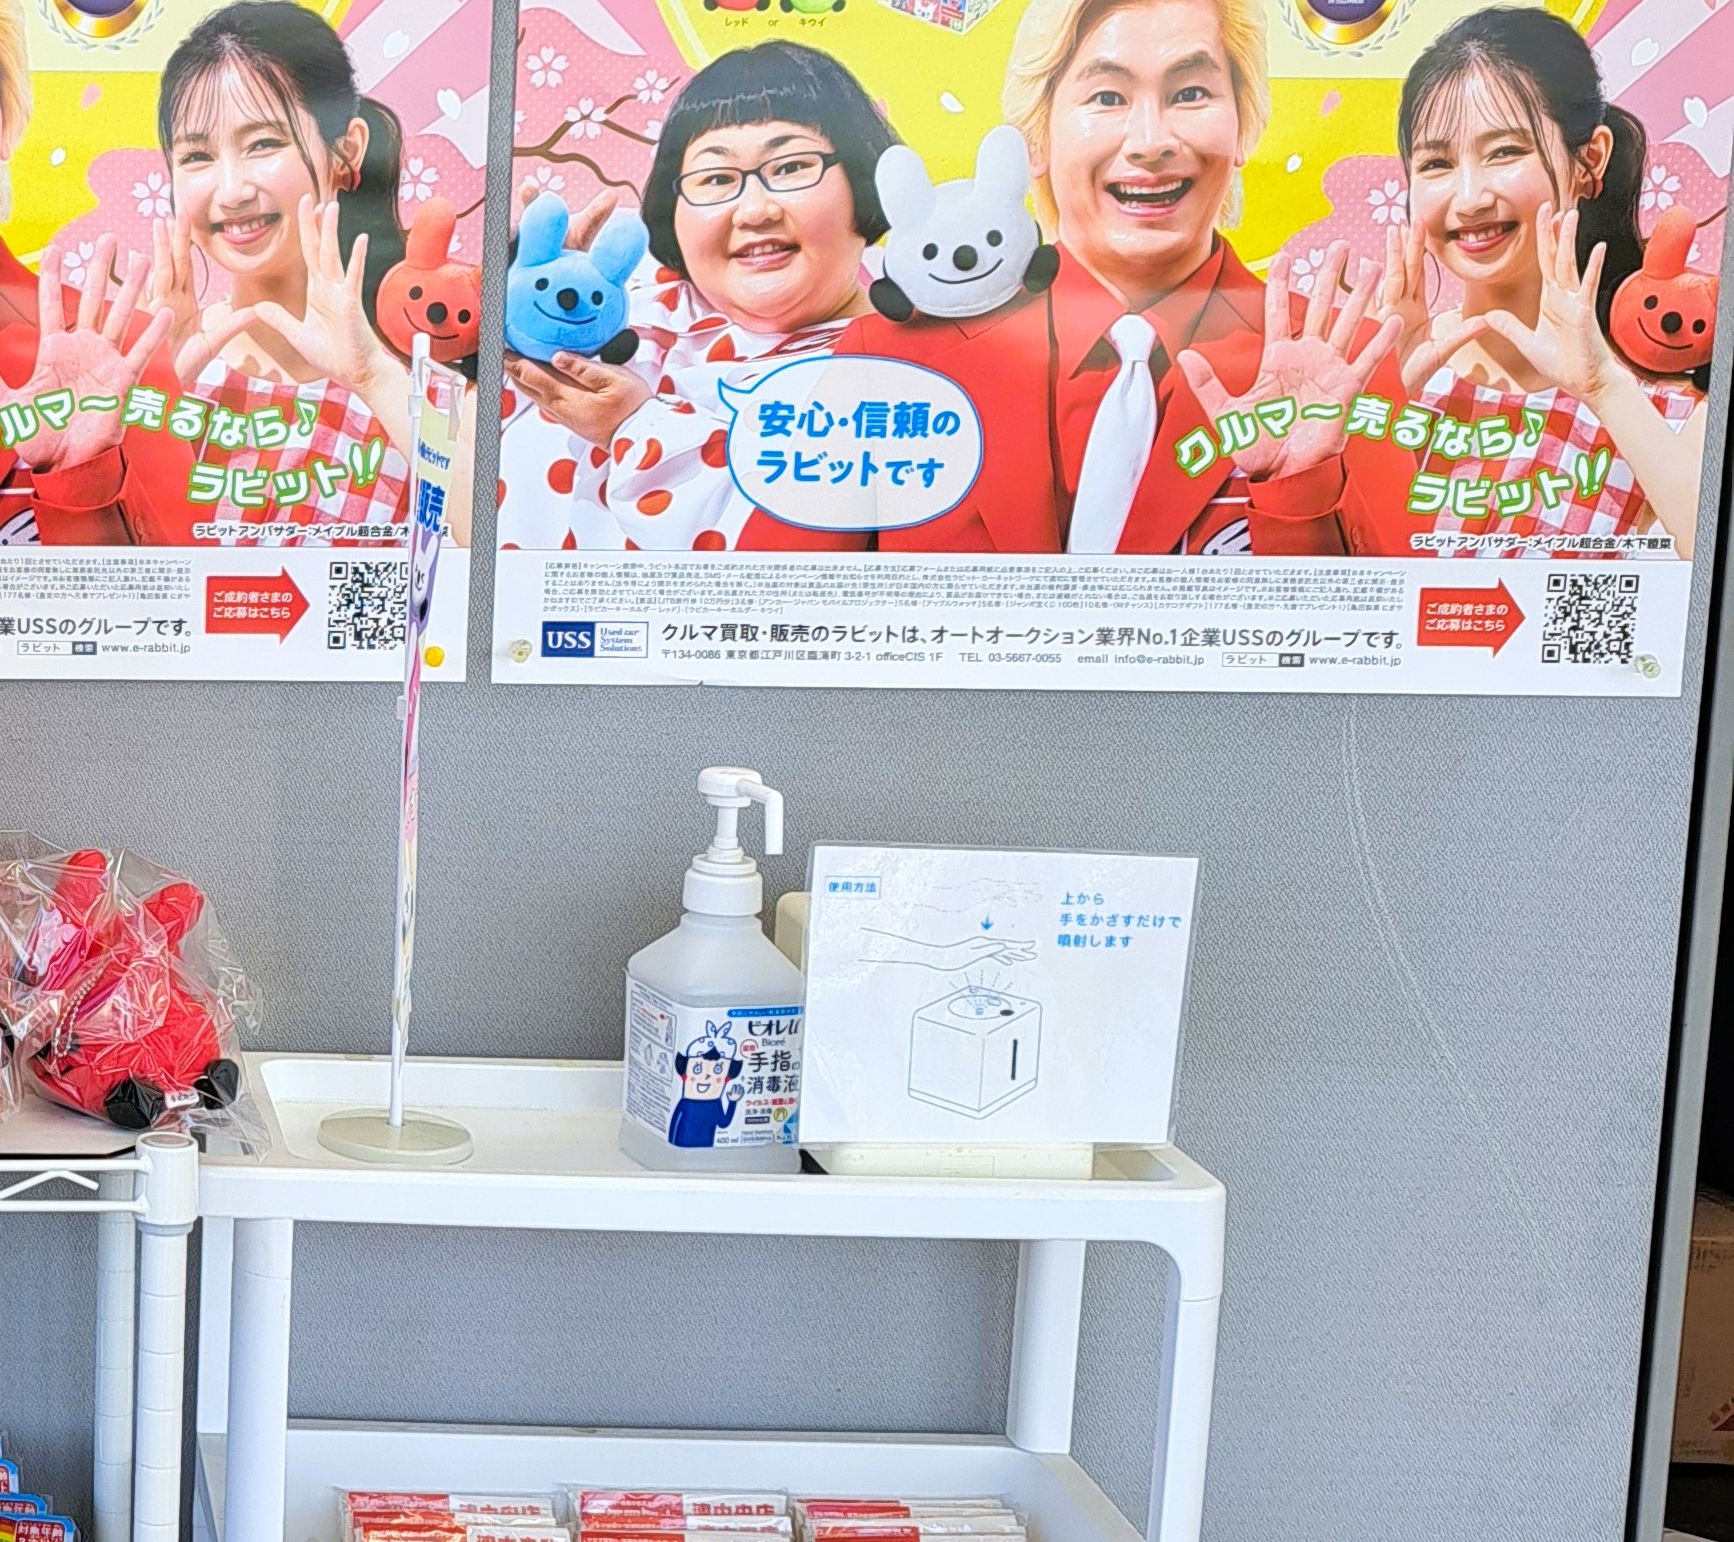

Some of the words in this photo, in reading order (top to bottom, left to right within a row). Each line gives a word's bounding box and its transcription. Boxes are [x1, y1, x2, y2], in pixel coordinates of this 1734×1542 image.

[758, 400, 960, 439] 安心・信頼の
[755, 452, 944, 488] ラビットです
[1426, 603, 1508, 615] ご成約者さまの
[1425, 619, 1505, 631] ご応募はこちら
[548, 631, 591, 649] USS
[102, 643, 190, 654] www.e-rabbit.jp
[960, 653, 982, 661] TEL
[1078, 654, 1109, 663] email
[1225, 655, 1266, 663] ラビット
[1310, 656, 1401, 666] www.e-rabbit.jp
[828, 881, 878, 894] 使用方法
[1061, 892, 1105, 906] 上から
[1059, 913, 1182, 928] 手をかざすだけで
[1057, 934, 1133, 948] 噴射します
